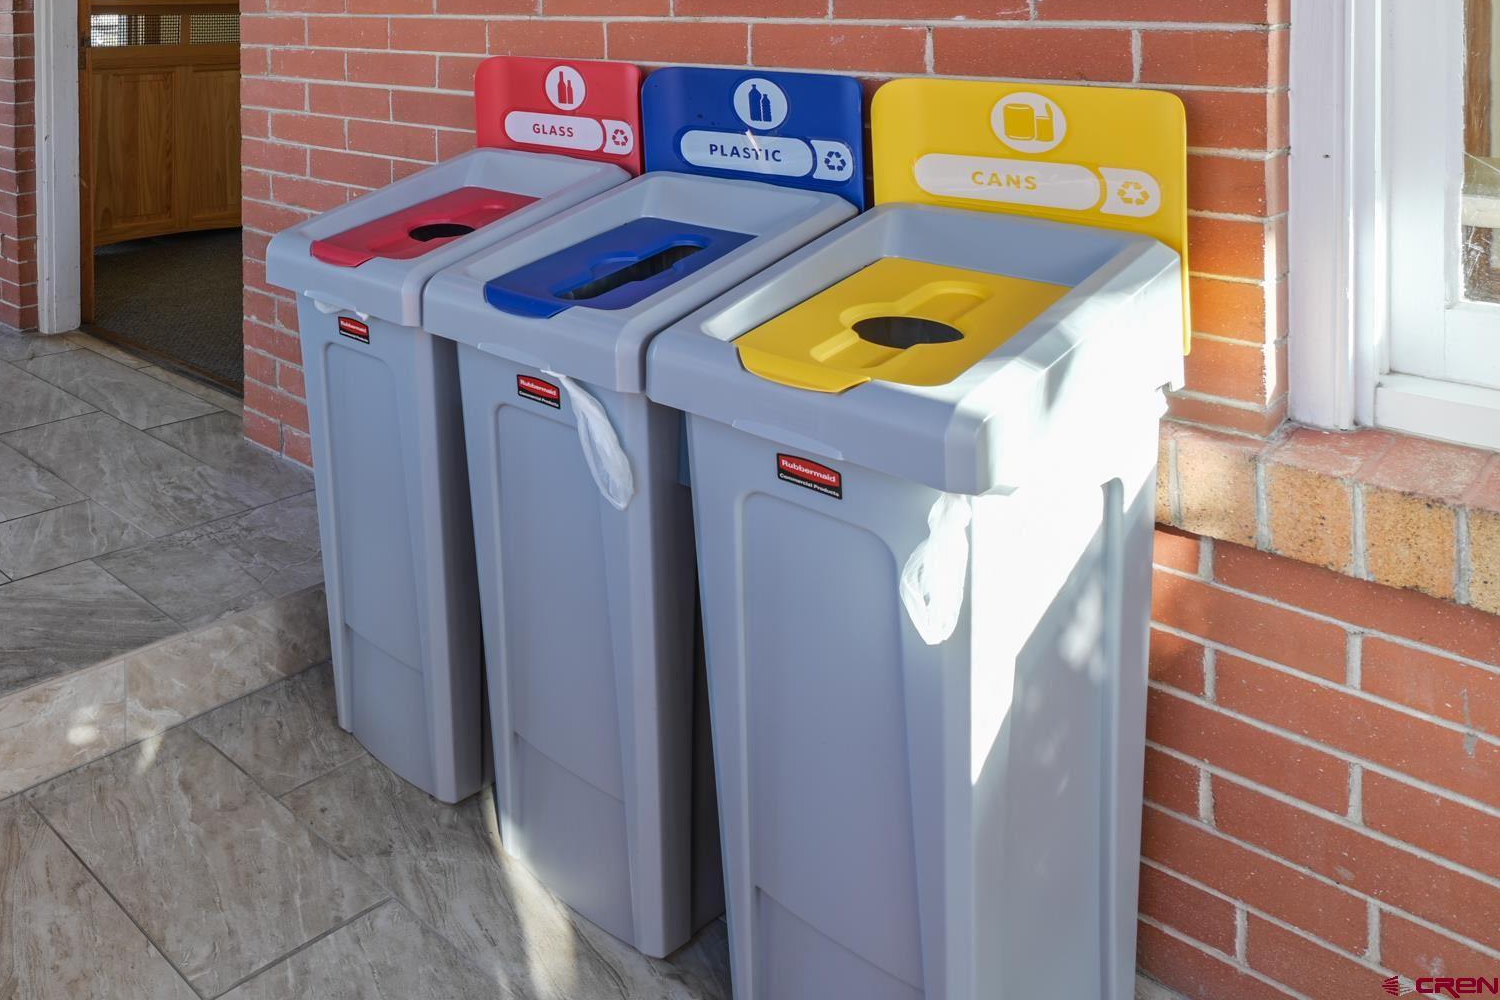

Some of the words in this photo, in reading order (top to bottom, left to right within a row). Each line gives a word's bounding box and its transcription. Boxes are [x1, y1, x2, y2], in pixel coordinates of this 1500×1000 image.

[532, 123, 574, 138] GLASS
[709, 143, 782, 162] PLASTIC
[971, 170, 1037, 191] CANS
[520, 379, 556, 395] Rubbermaid
[781, 460, 836, 482] Rubbermaid
[780, 473, 813, 488] Commercial
[814, 482, 839, 497] Products
